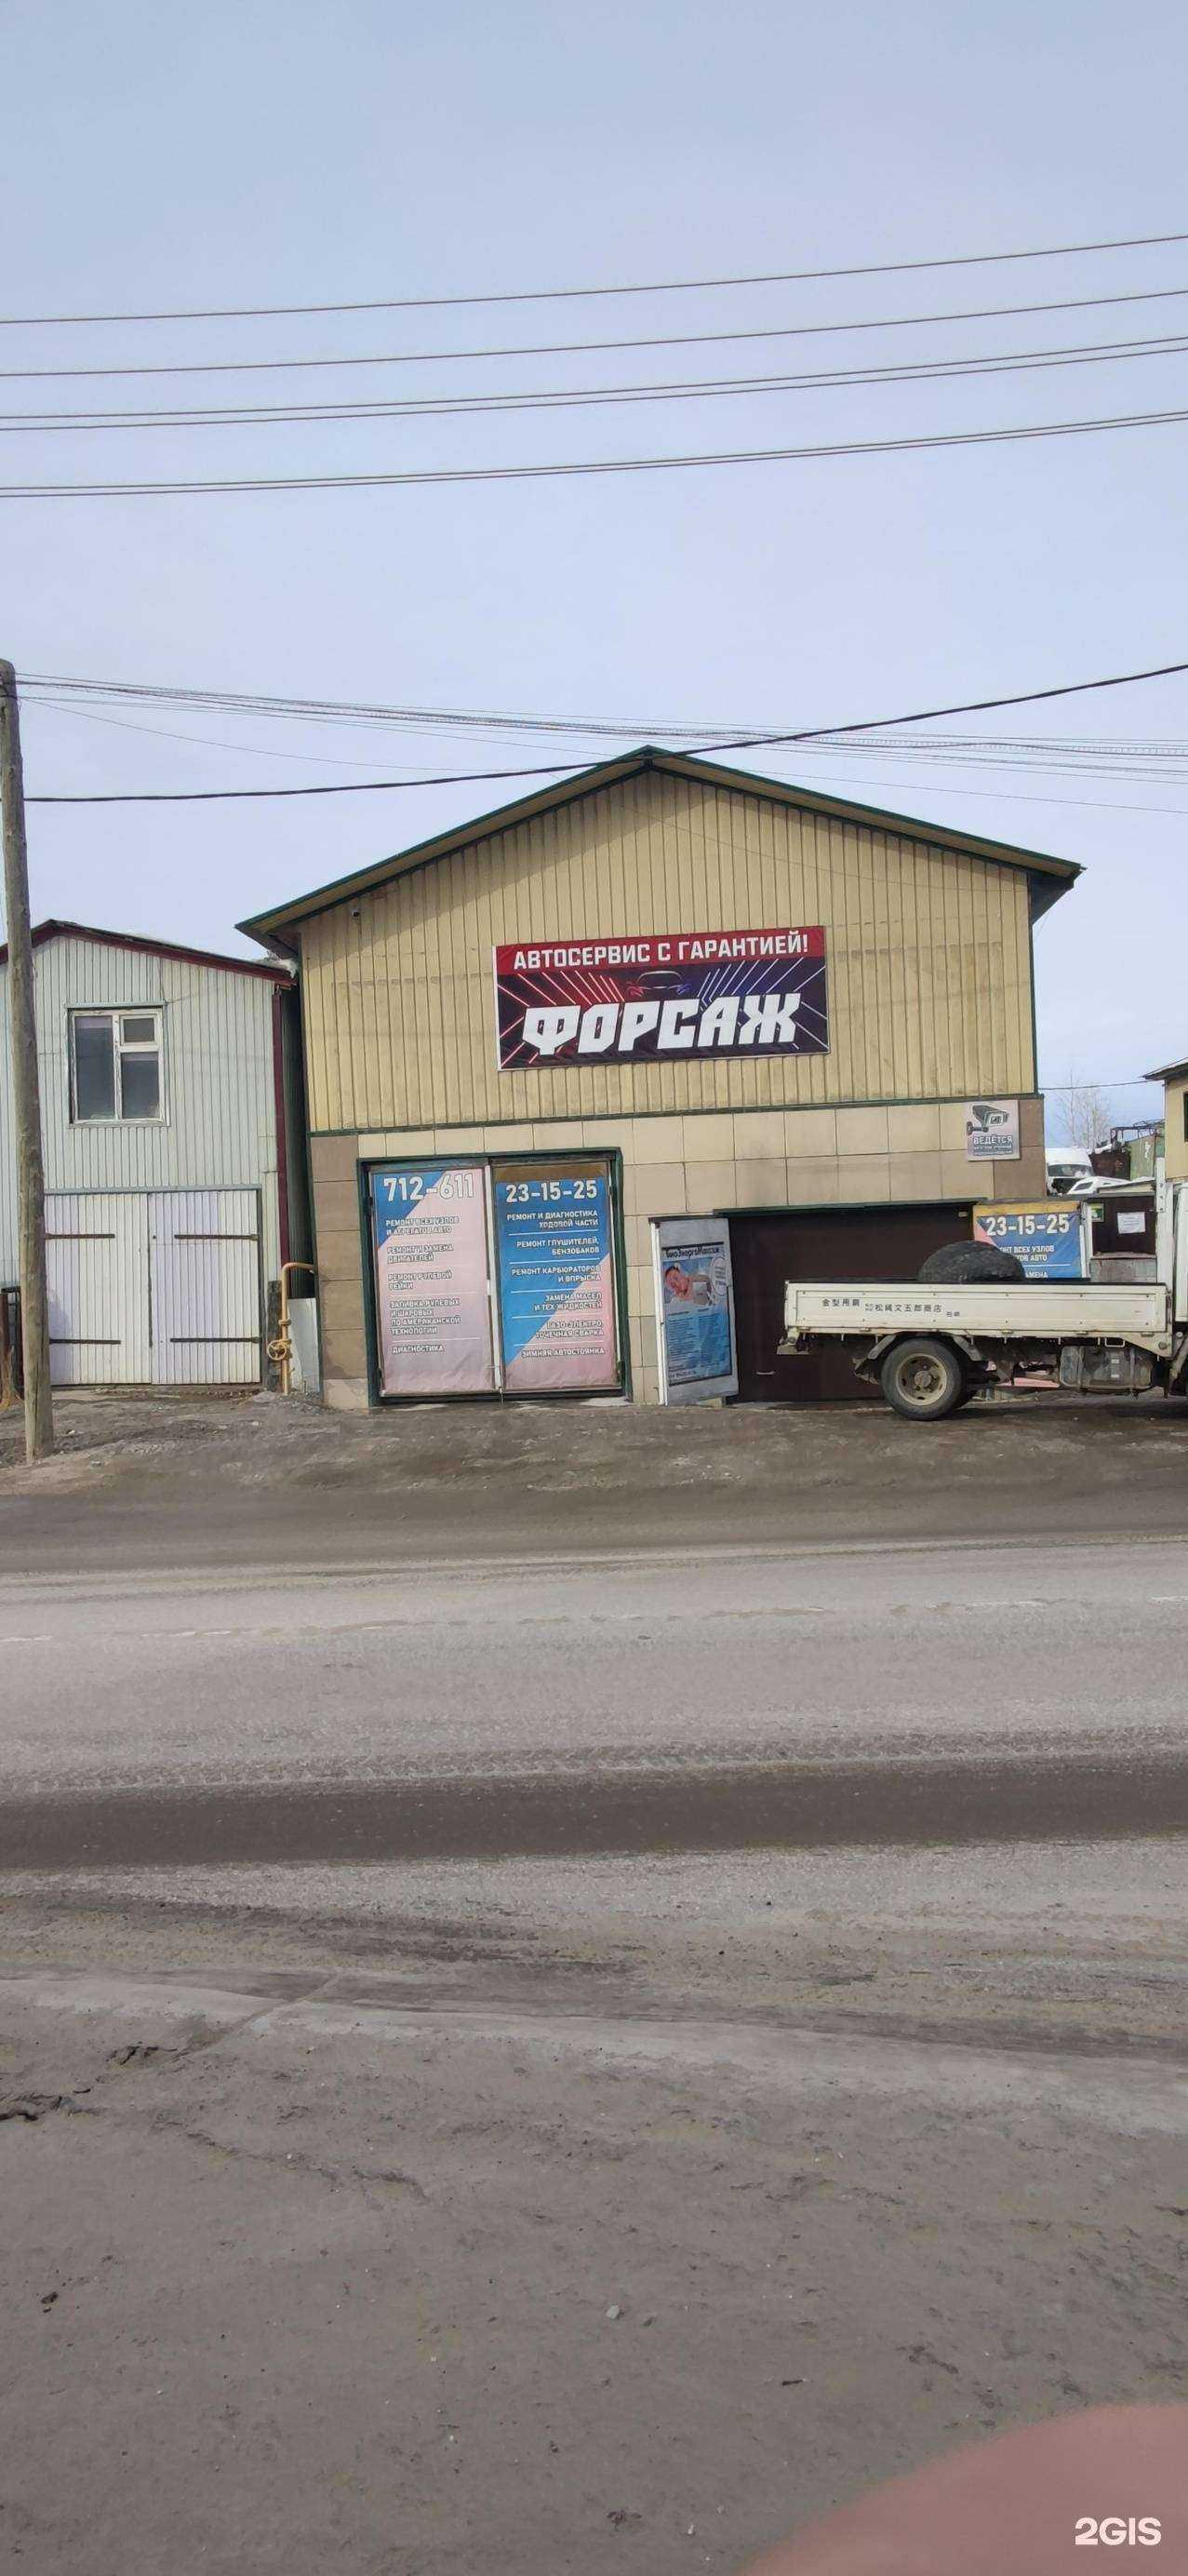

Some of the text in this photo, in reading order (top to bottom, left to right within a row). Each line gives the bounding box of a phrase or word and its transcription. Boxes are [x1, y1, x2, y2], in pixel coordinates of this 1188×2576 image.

[514, 931, 808, 971] АВТОСЕРВИС С ГАРАНТИЕЙ!
[522, 992, 801, 1056] ФОРСАЖ
[383, 1173, 474, 1202] 712-611
[505, 1179, 597, 1203] 23-15-25
[507, 1213, 537, 1221] РЕМОНТ
[544, 1210, 598, 1220] ДИАГНОСТИКА
[539, 1219, 573, 1228] ХОДОВОЙ
[986, 1213, 1070, 1237] 23-15-25
[516, 1240, 546, 1248] РЕМОНТ
[1013, 1245, 1031, 1254] ВСЕХ
[1032, 1244, 1055, 1253] УЗЛОВ
[551, 1247, 600, 1256] БЕНЗОБАКОВ
[1030, 1254, 1048, 1262] АВТО
[512, 1265, 601, 1276] РЕМОНТ КАРБЮРАТОРОВ
[393, 1345, 444, 1354] ДИАГНОСТИКА
